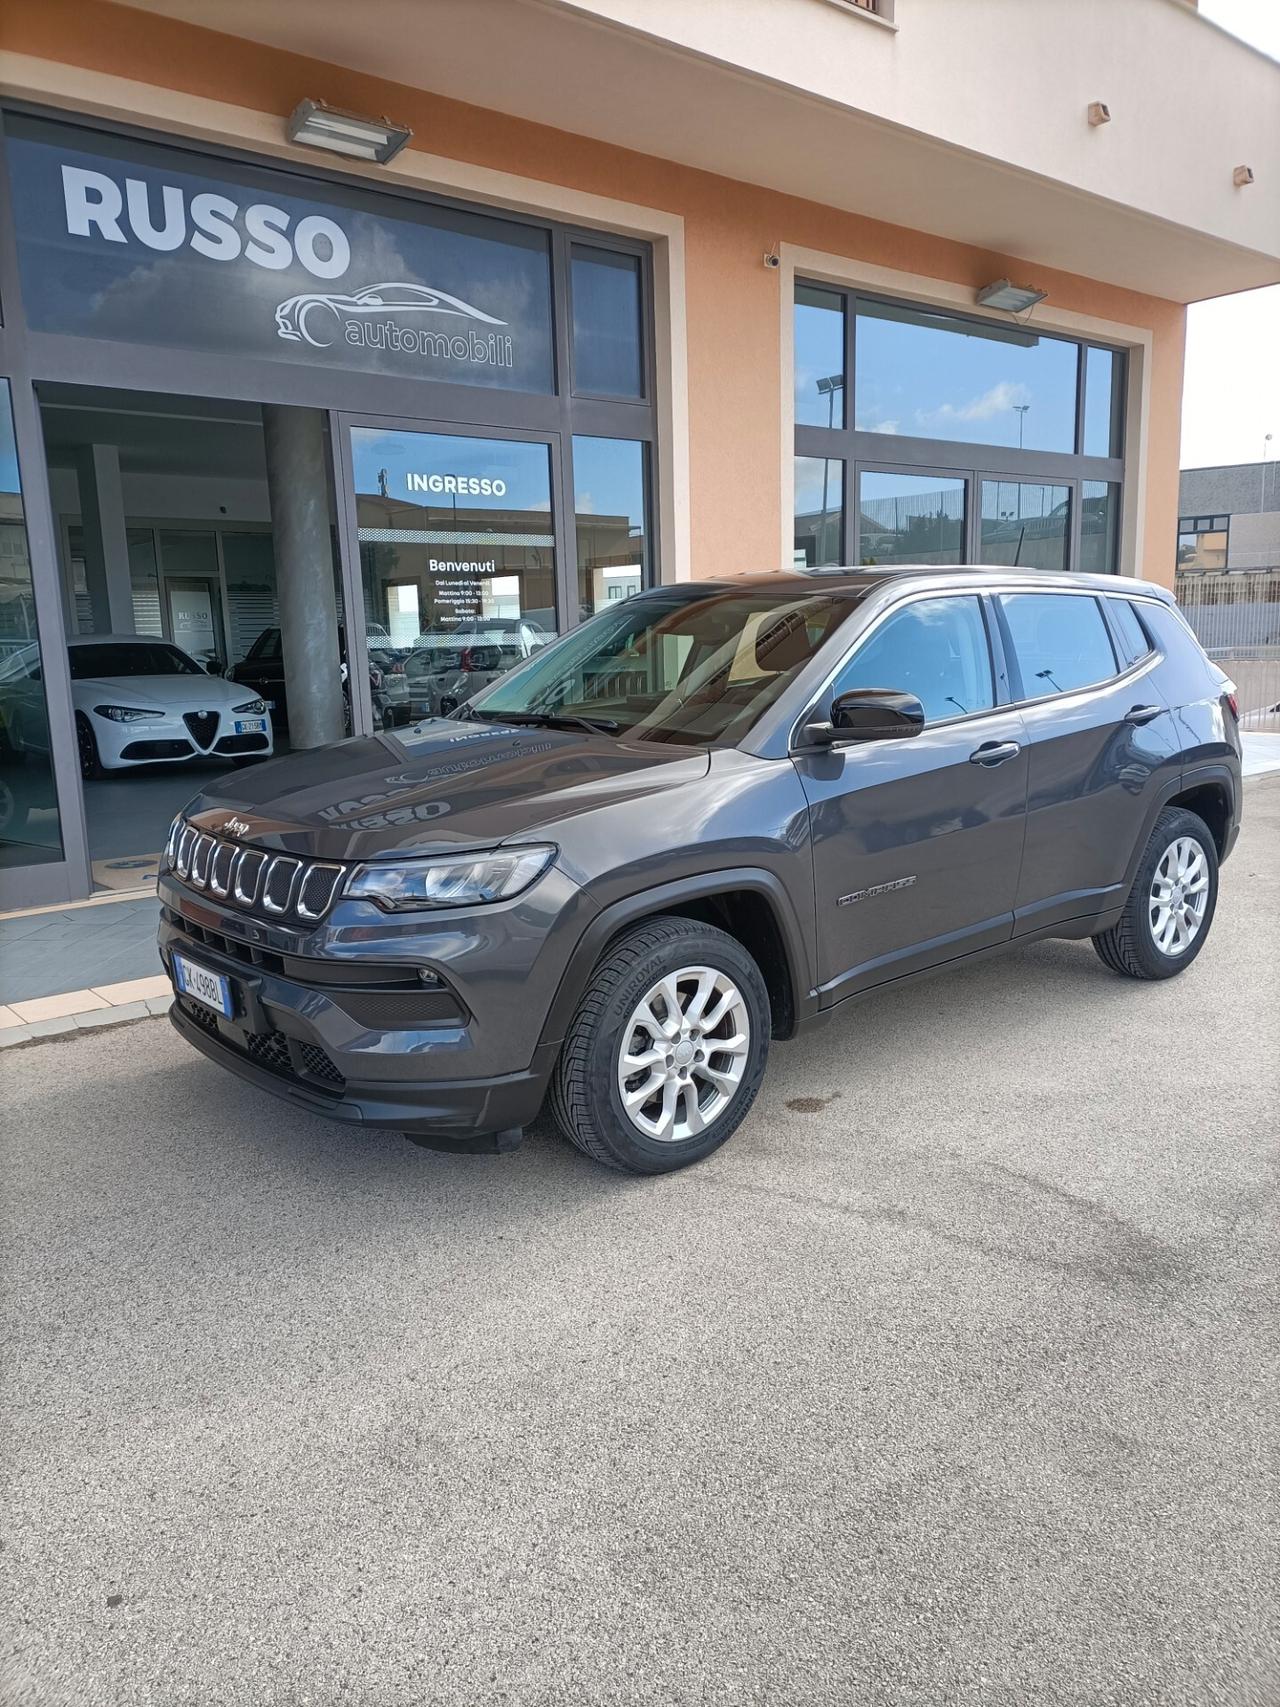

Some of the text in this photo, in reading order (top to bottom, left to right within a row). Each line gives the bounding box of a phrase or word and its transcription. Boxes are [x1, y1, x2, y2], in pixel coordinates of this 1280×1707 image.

[61, 164, 351, 280] RUSSO
[344, 317, 514, 368] automobili
[406, 473, 507, 497] INGRESSO
[428, 559, 496, 573] Benvenuti
[613, 954, 665, 1016] UNIROYAL
